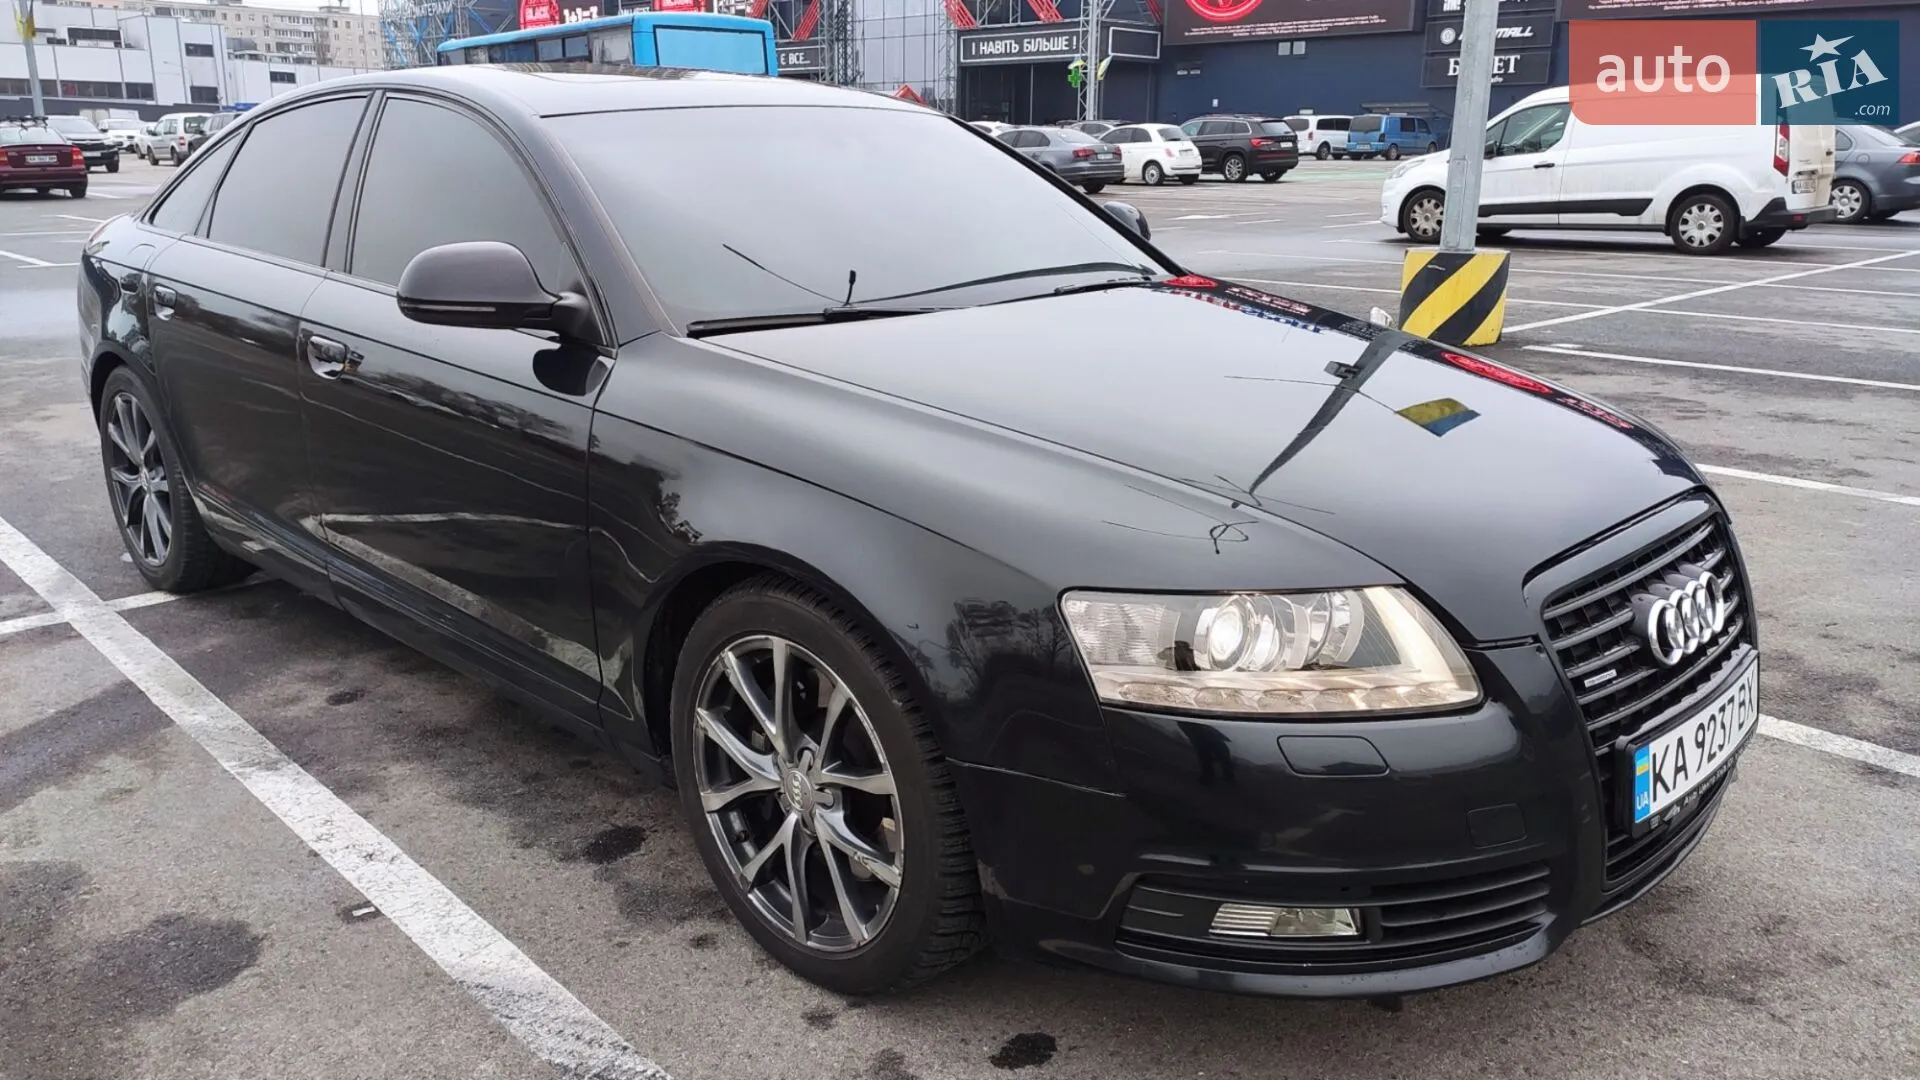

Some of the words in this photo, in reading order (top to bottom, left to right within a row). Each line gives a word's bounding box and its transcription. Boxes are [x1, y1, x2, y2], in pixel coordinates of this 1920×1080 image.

[979, 40, 1019, 55] НАВІТЬ
[1023, 36, 1069, 53] БІЛЬШЕ
[1652, 736, 1688, 802] KA
[1694, 694, 1735, 775] 9237
[1738, 677, 1754, 731] BX
[1636, 791, 1649, 810] UA
